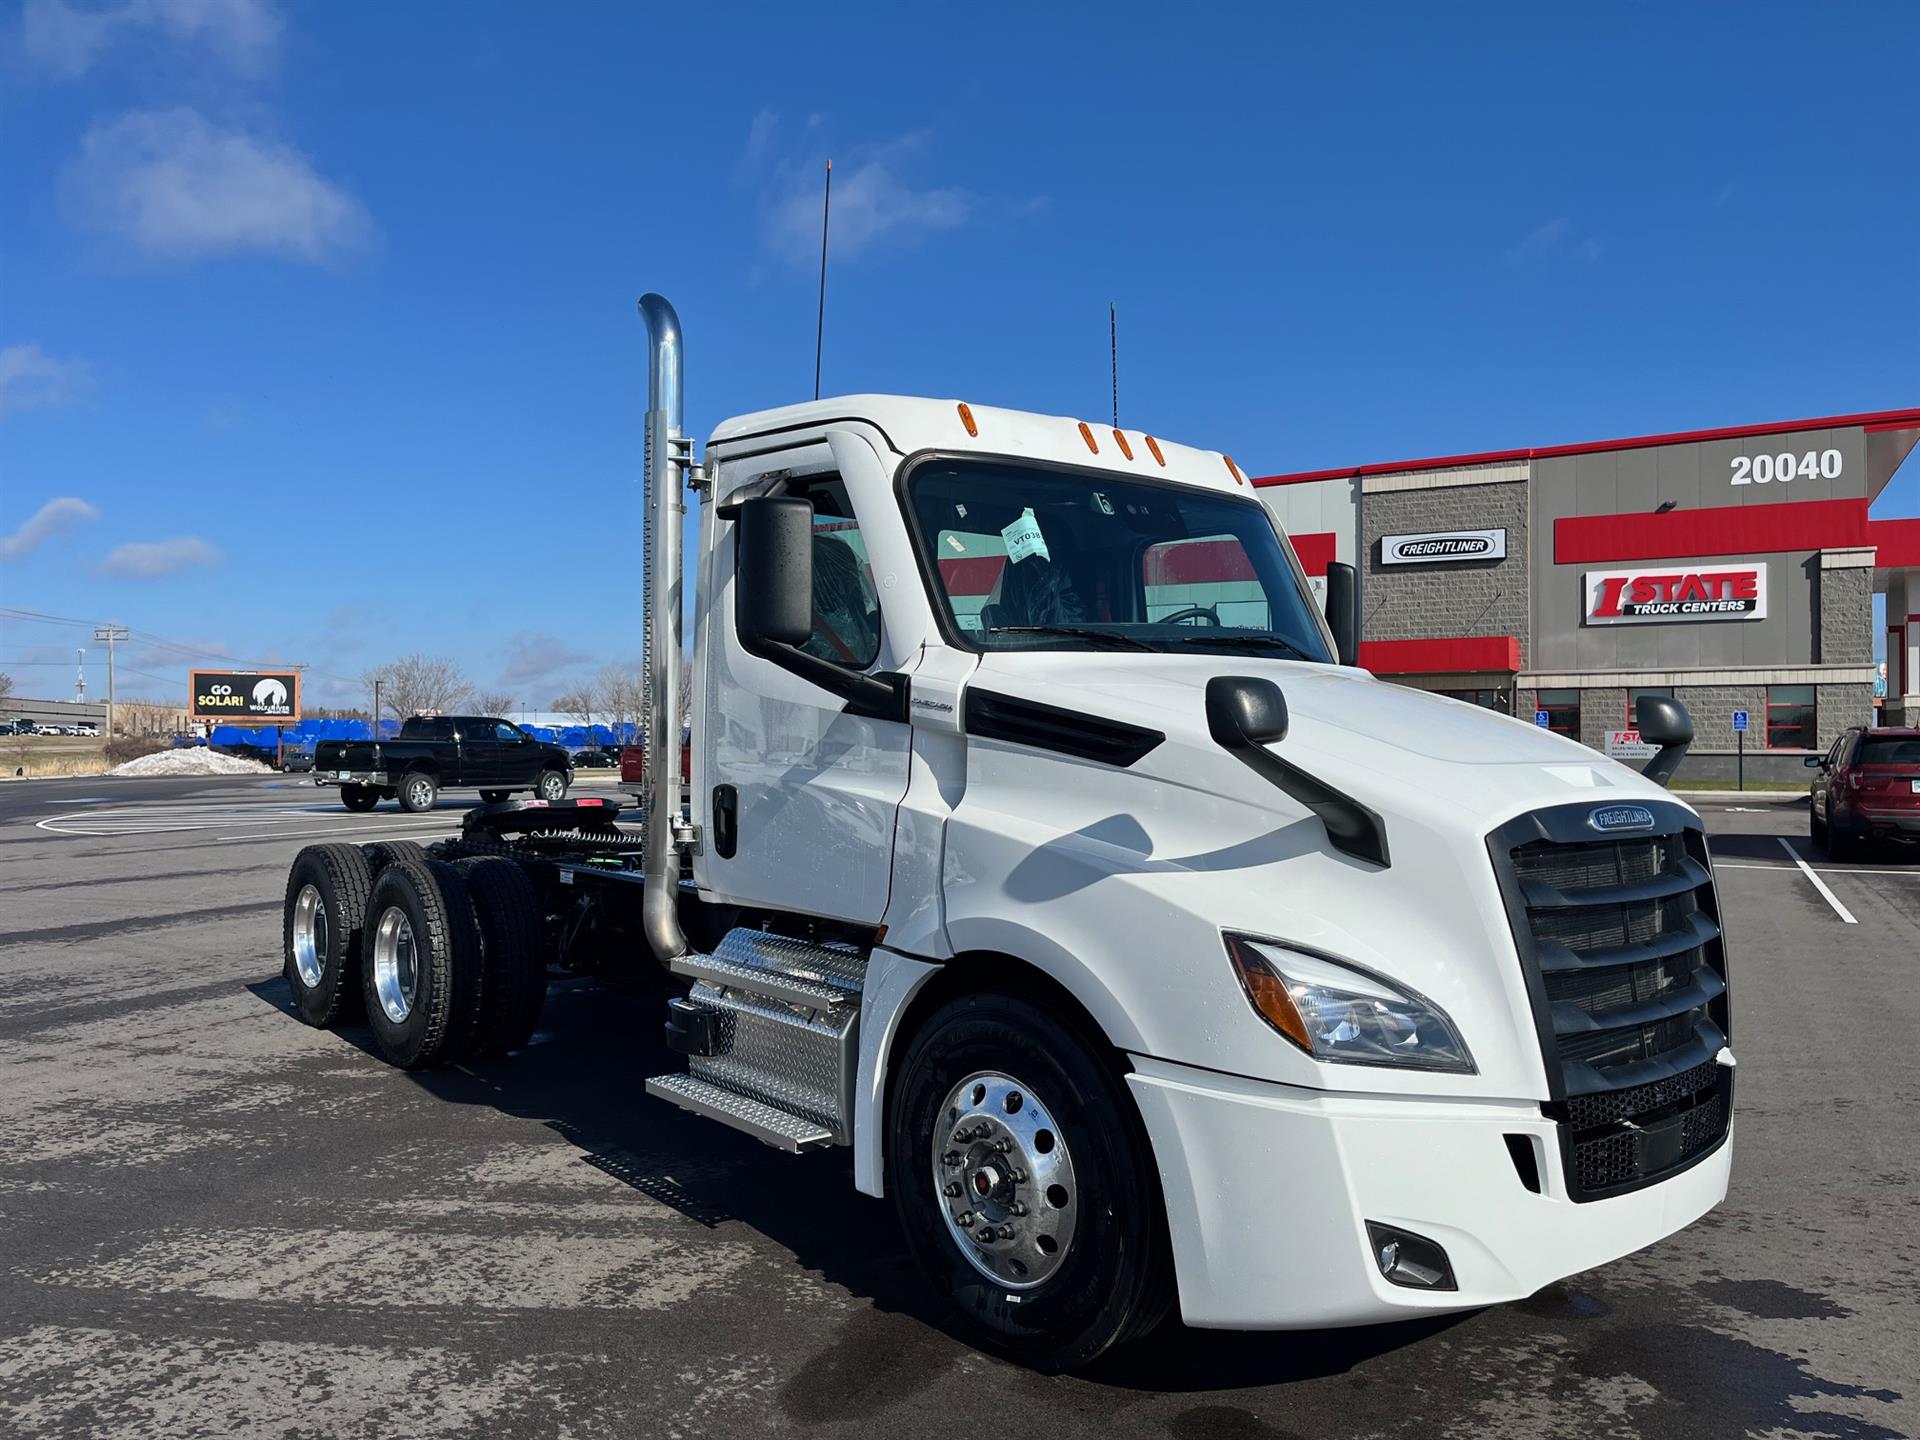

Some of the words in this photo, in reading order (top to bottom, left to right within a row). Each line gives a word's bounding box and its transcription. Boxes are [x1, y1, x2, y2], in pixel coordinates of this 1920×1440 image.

[1730, 449, 1843, 485] 20040
[1402, 541, 1485, 555] FREIGHTLINER
[1631, 571, 1758, 604] STATE
[1634, 603, 1679, 615] TRUCK
[1682, 600, 1745, 613] CENTERS
[211, 684, 232, 696] GO
[198, 695, 244, 707] SOLAR!
[1599, 810, 1650, 826] FREIGHTLINER
